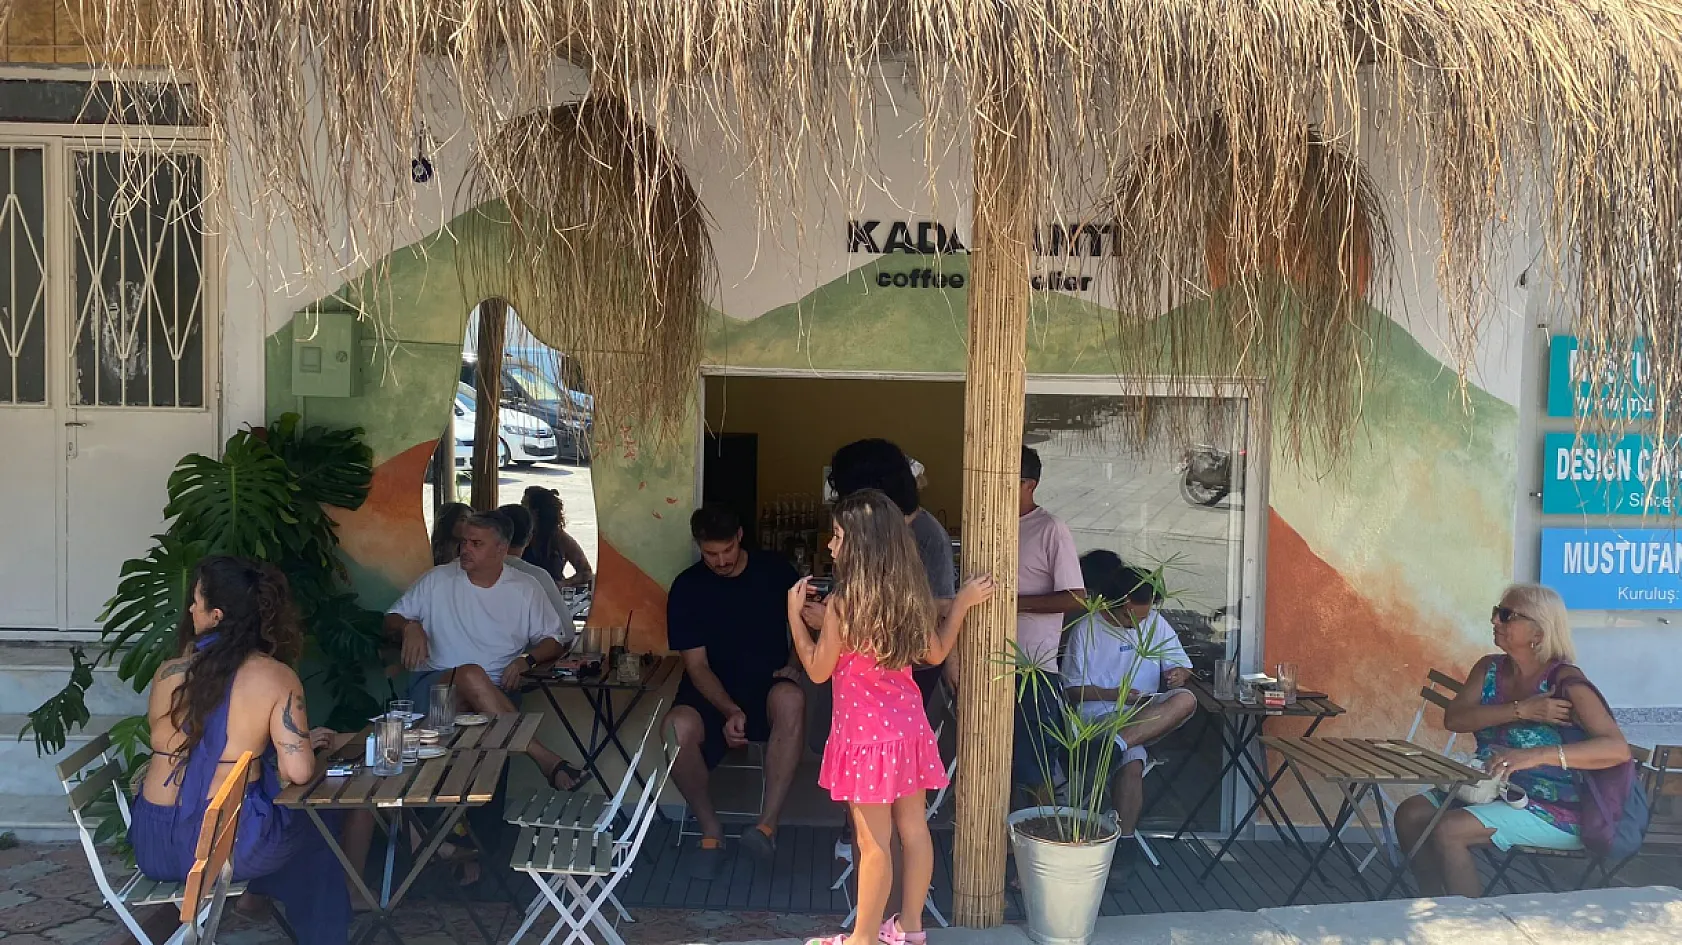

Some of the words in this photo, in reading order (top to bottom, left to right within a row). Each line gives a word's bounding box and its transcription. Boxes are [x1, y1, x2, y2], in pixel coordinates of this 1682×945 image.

[877, 268, 964, 288] coffee
[1557, 448, 1632, 481] DESIGN
[1618, 586, 1680, 603] Kuruluş:
